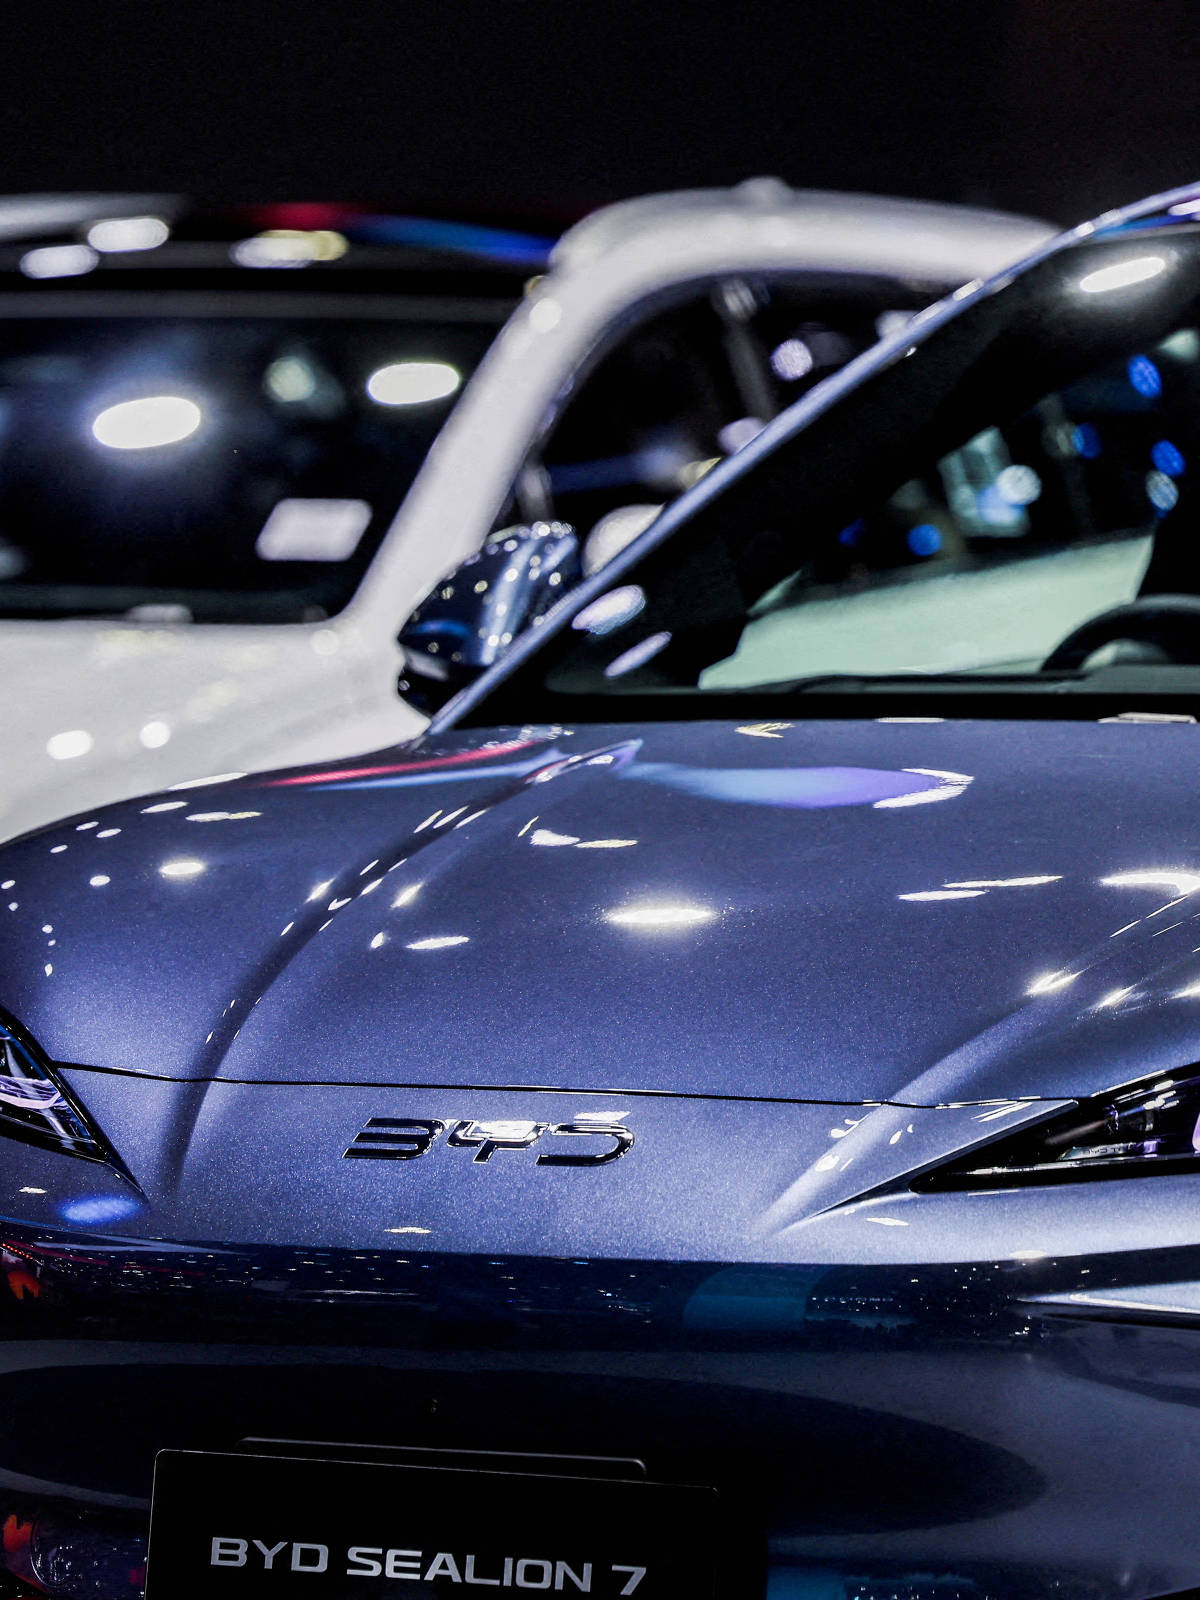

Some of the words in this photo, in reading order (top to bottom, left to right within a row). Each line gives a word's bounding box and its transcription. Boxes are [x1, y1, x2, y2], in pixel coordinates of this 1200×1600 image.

[342, 1113, 635, 1167] BYD
[210, 1536, 329, 1574] BYD
[346, 1546, 593, 1594] SEALION
[611, 1564, 648, 1596] 7
